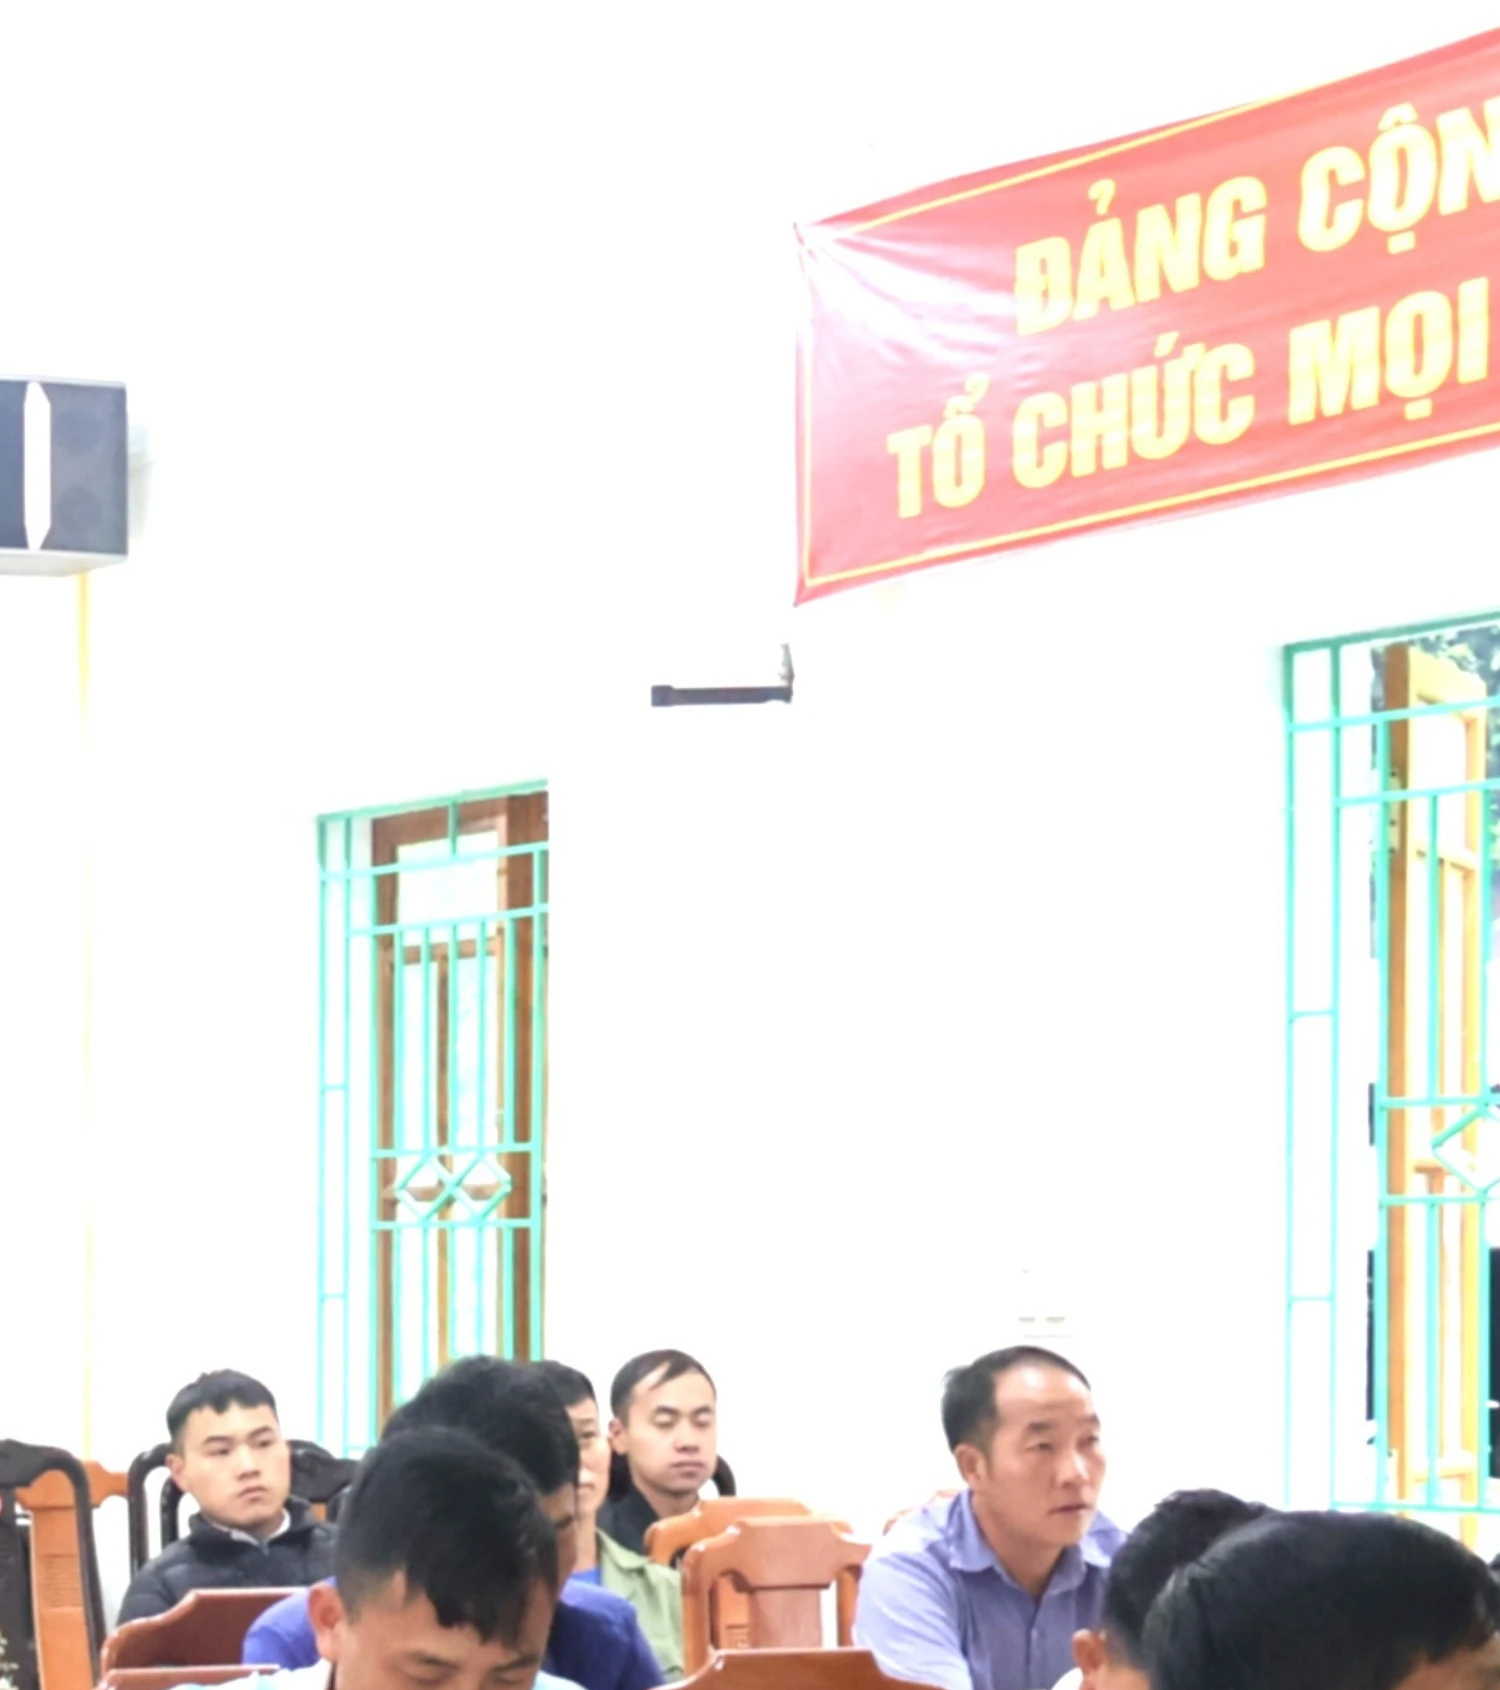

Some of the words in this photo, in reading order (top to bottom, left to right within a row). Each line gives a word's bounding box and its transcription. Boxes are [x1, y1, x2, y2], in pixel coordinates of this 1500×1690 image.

[1014, 178, 1267, 337] ĐẢNG
[887, 372, 989, 518] TỔ
[1012, 331, 1255, 489] CHỨC
[1288, 276, 1489, 425] MỌI
